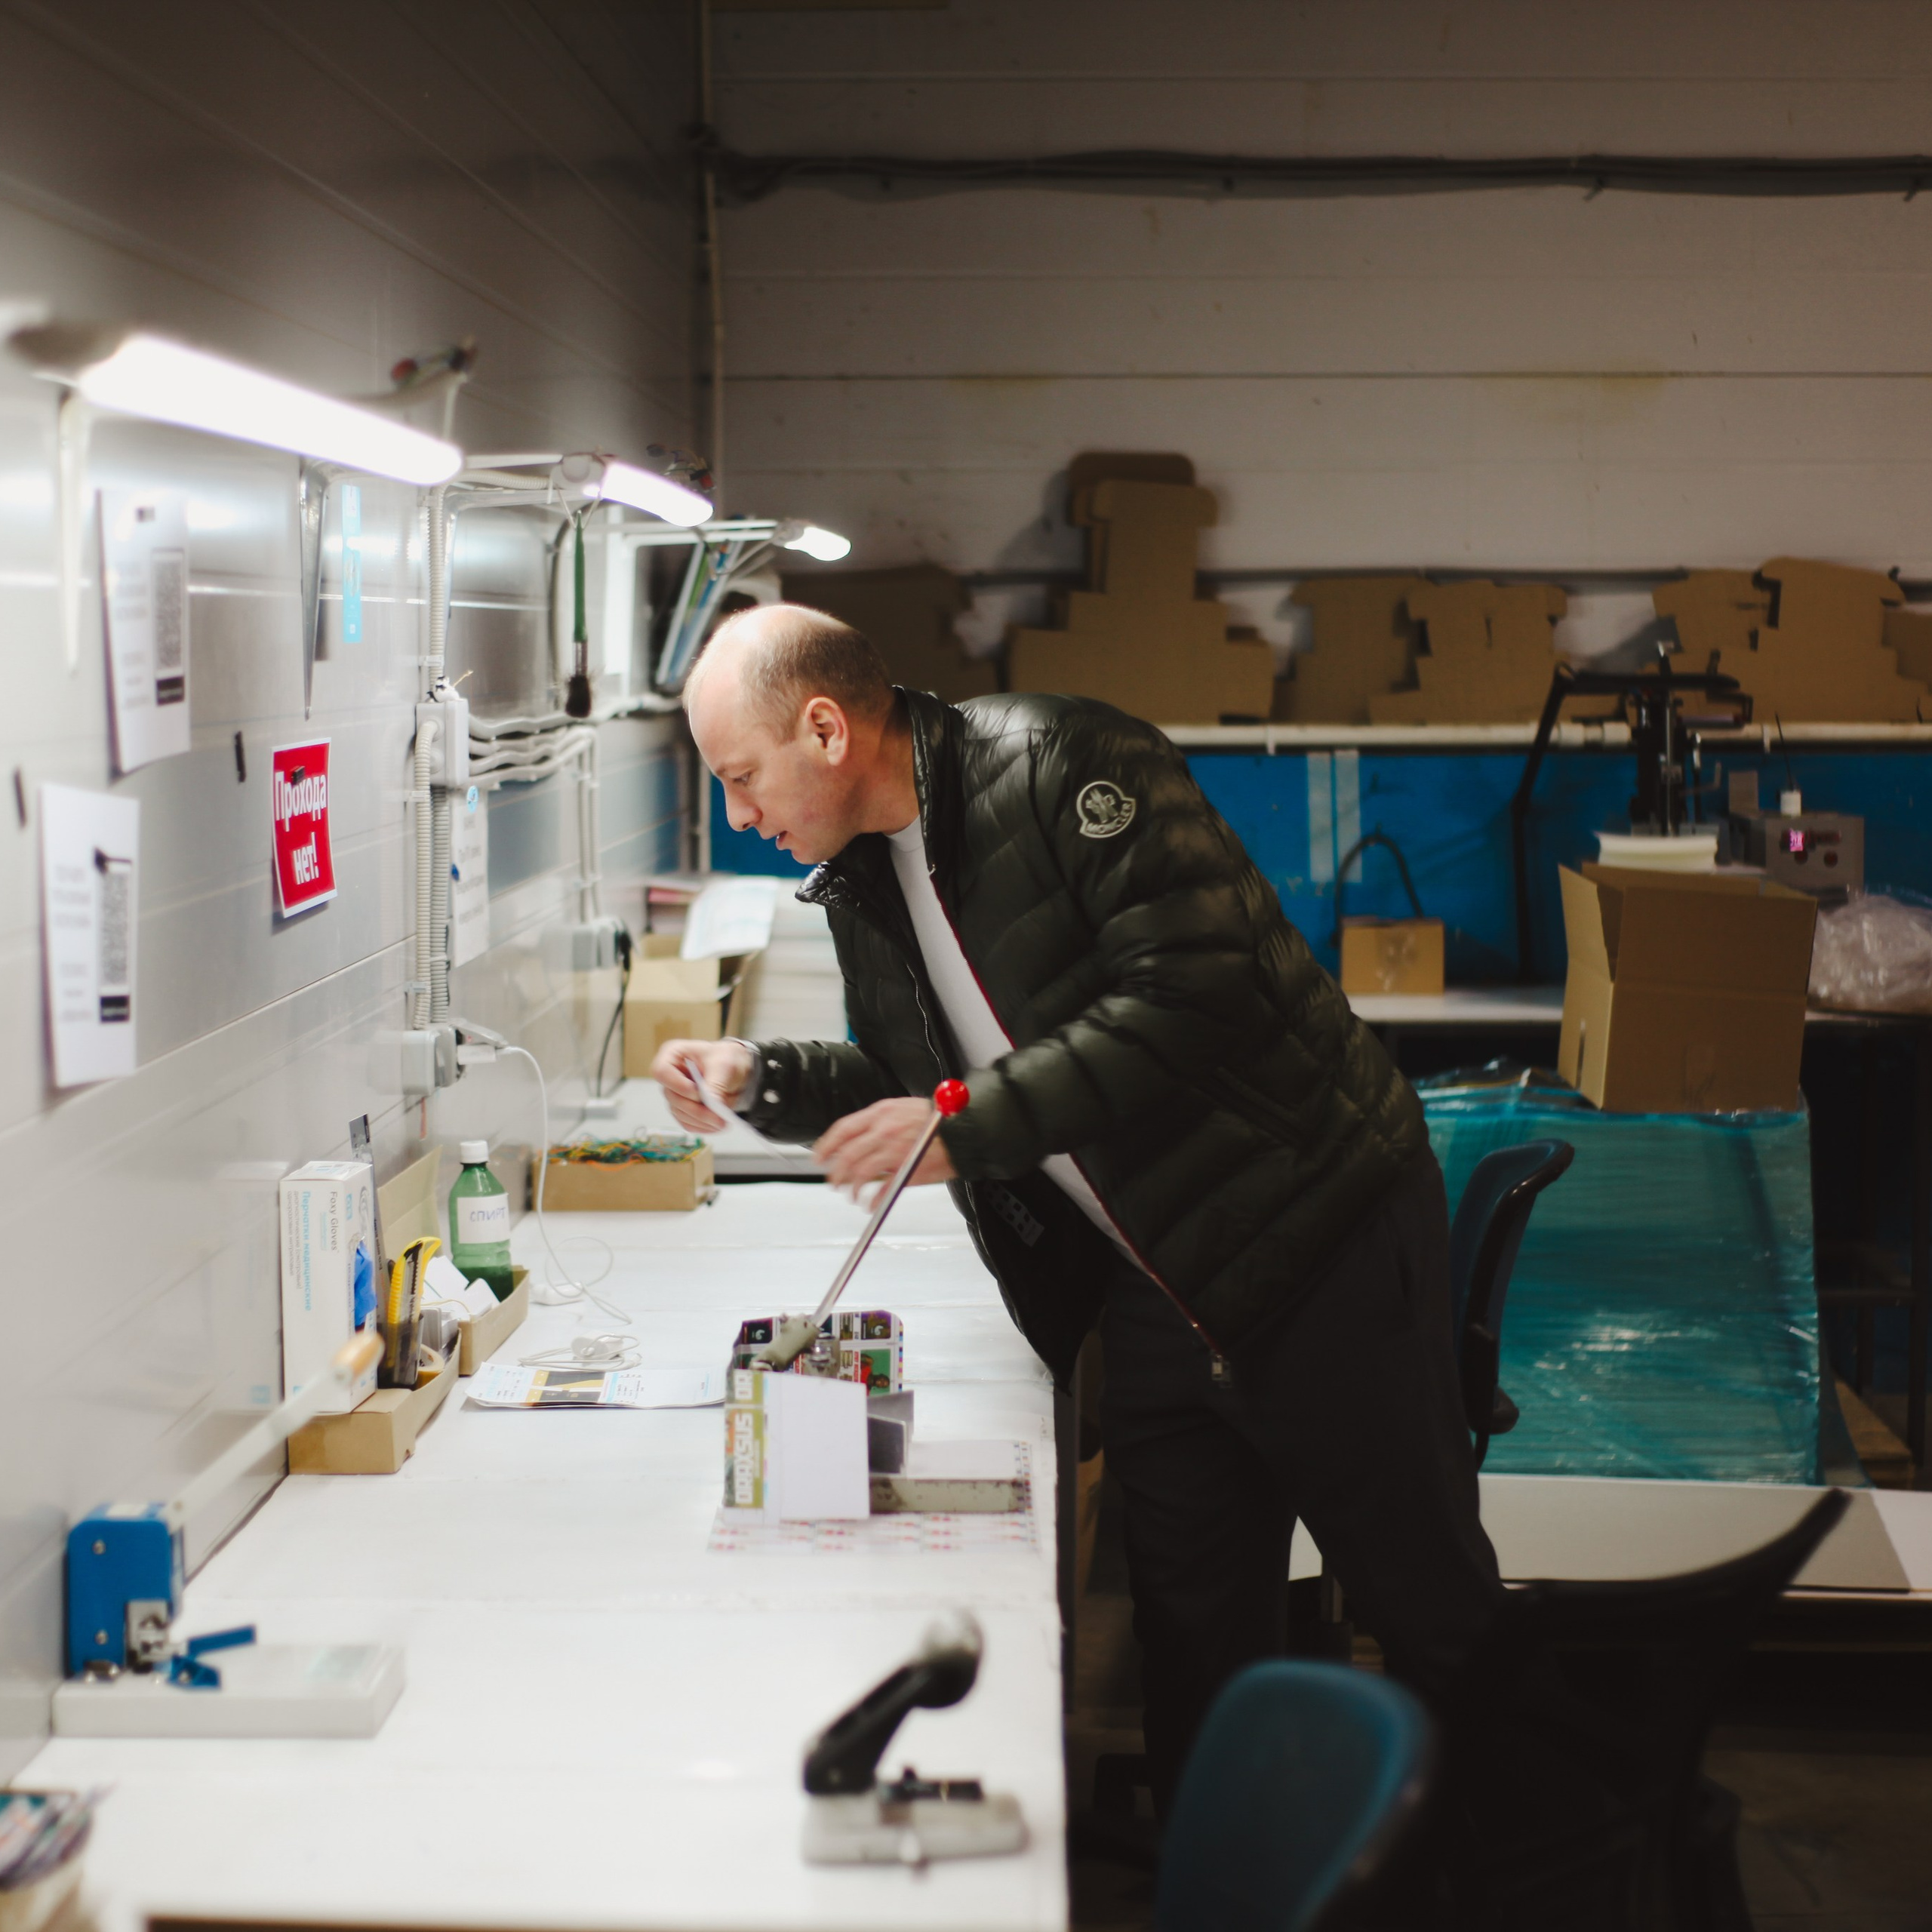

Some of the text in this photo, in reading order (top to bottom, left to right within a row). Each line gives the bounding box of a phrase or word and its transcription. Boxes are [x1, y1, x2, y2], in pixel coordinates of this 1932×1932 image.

[275, 771, 327, 832] Прохода
[293, 832, 320, 884] нет!
[328, 1191, 339, 1251] Foxy Gloves
[301, 1191, 311, 1312] Перчатки медицинские
